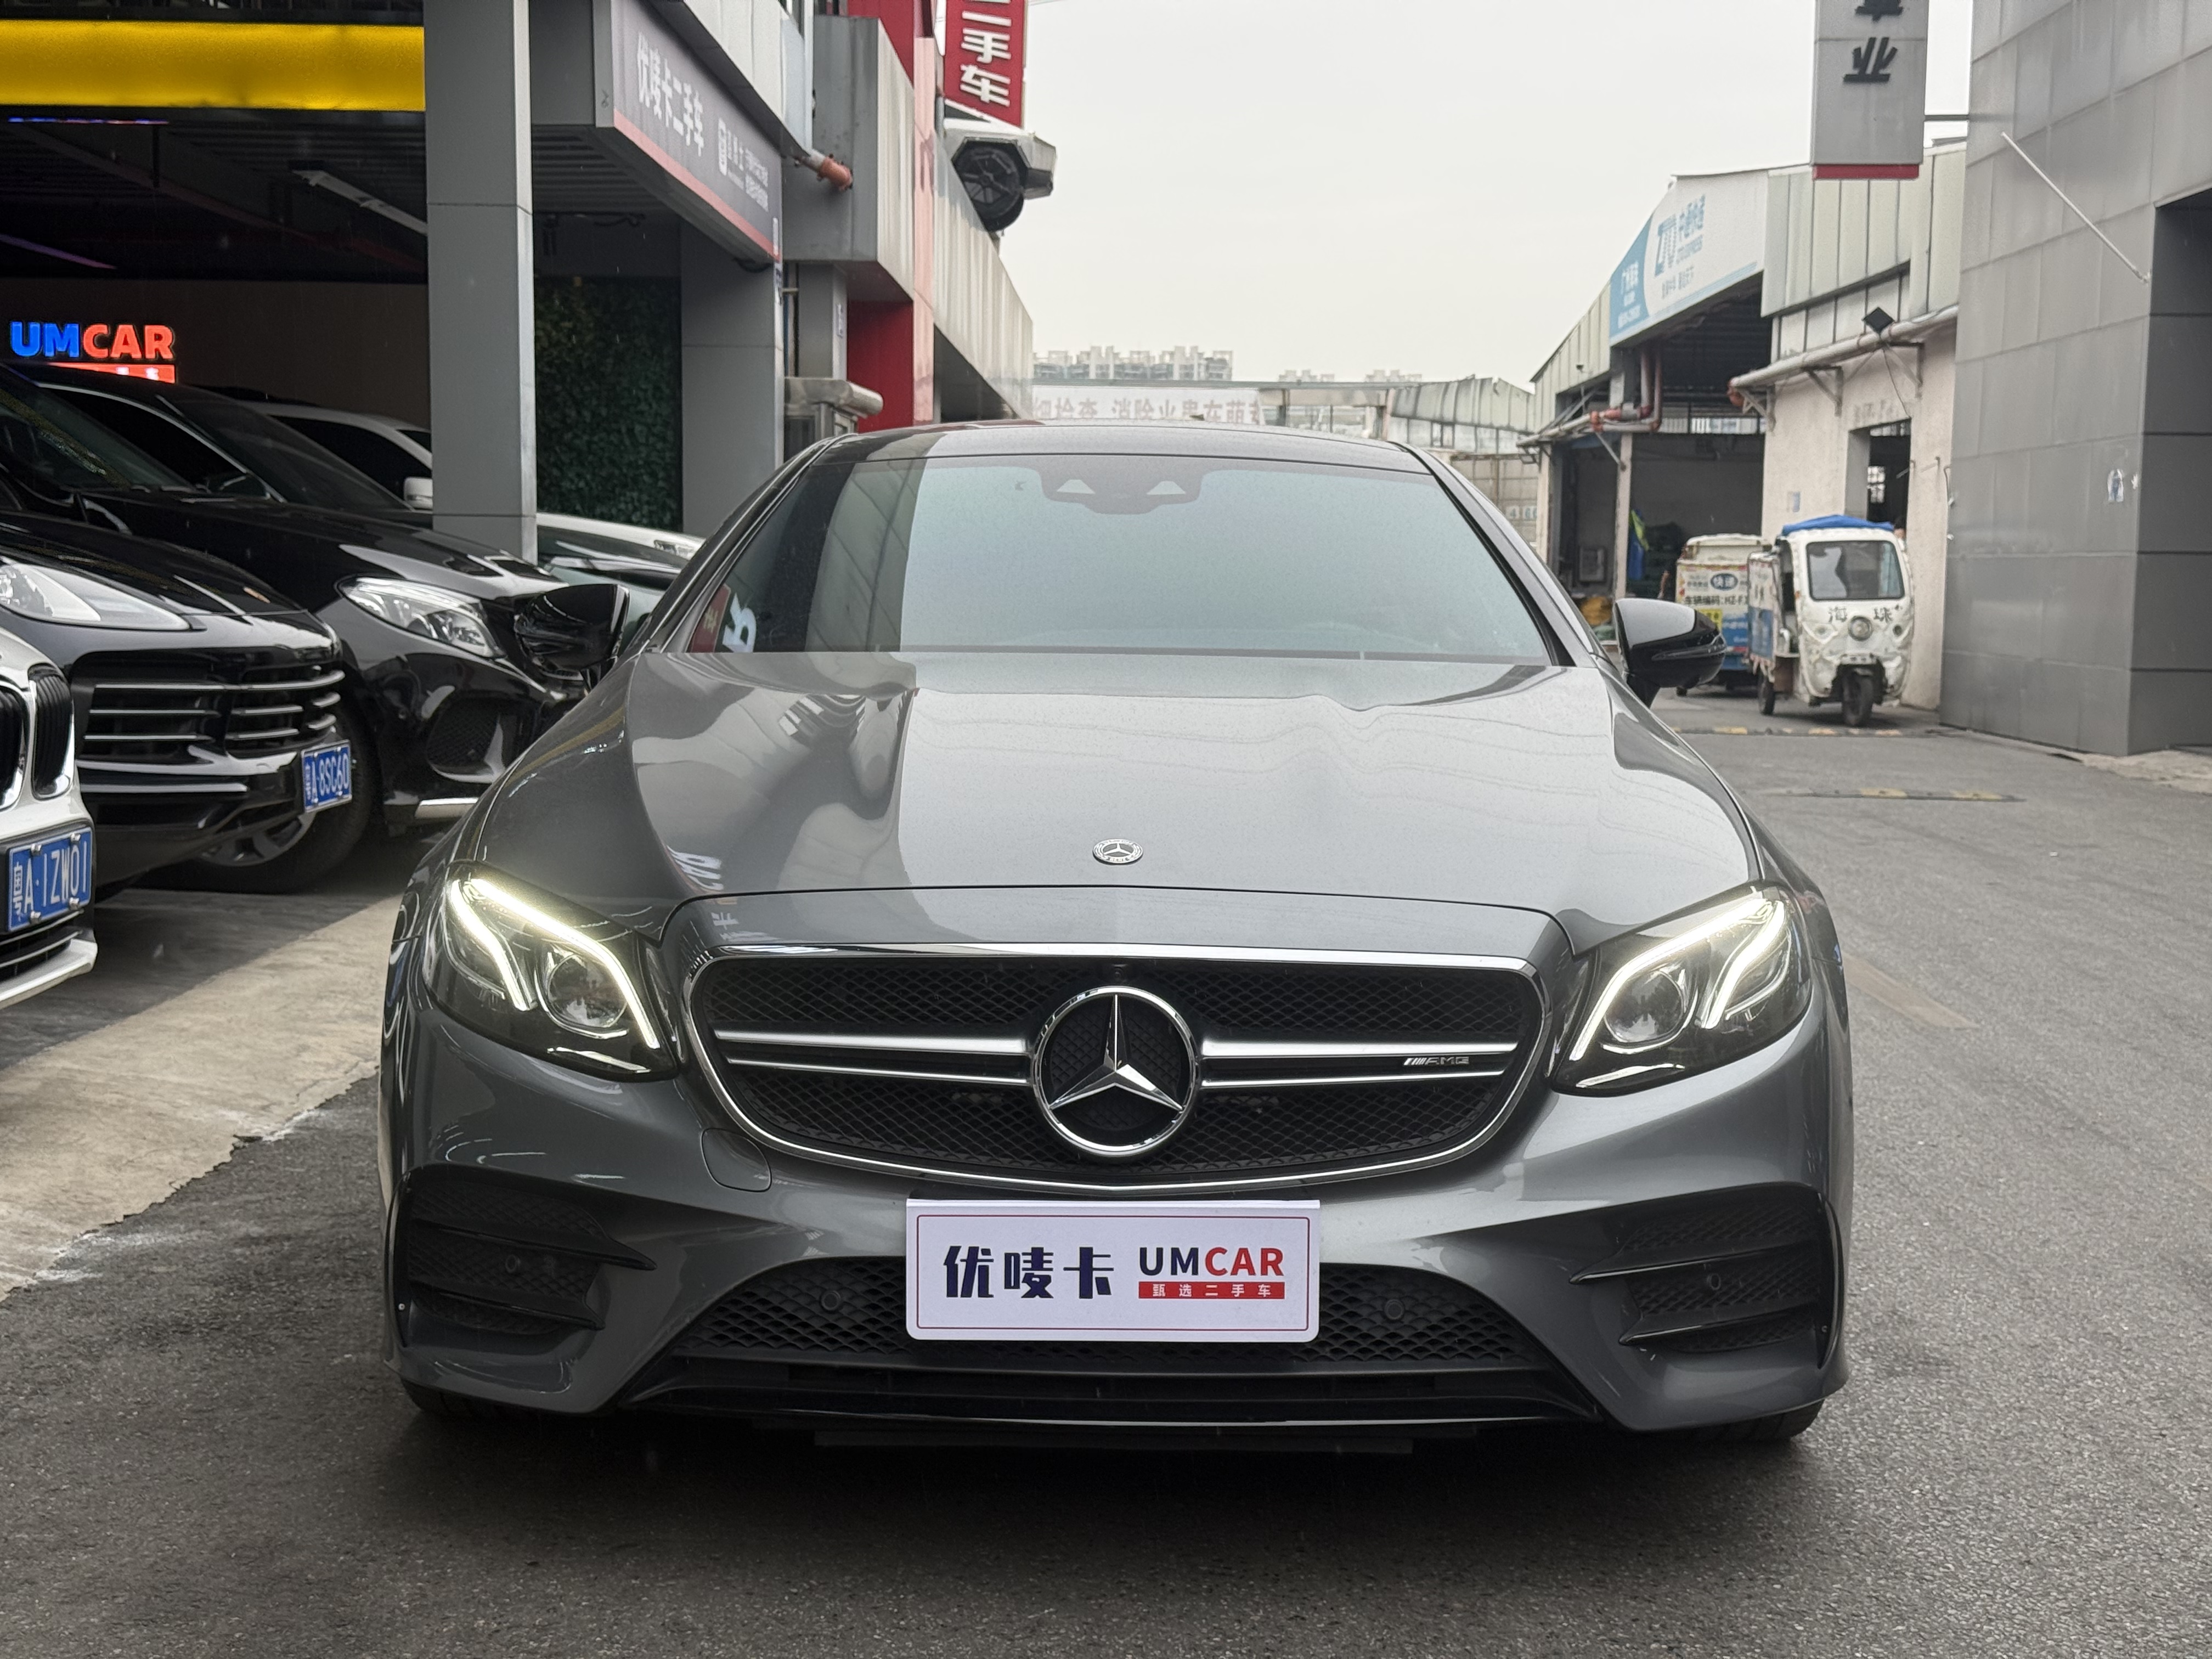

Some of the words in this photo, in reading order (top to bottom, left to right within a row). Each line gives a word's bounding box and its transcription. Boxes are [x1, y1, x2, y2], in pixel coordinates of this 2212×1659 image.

[960, 0, 1012, 107] 二手车
[10, 321, 173, 359] UMCAR
[943, 1245, 1114, 1299] 优唛卡
[1139, 1247, 1284, 1277] UMCAR
[1152, 1283, 1271, 1297] 甄选二手车
